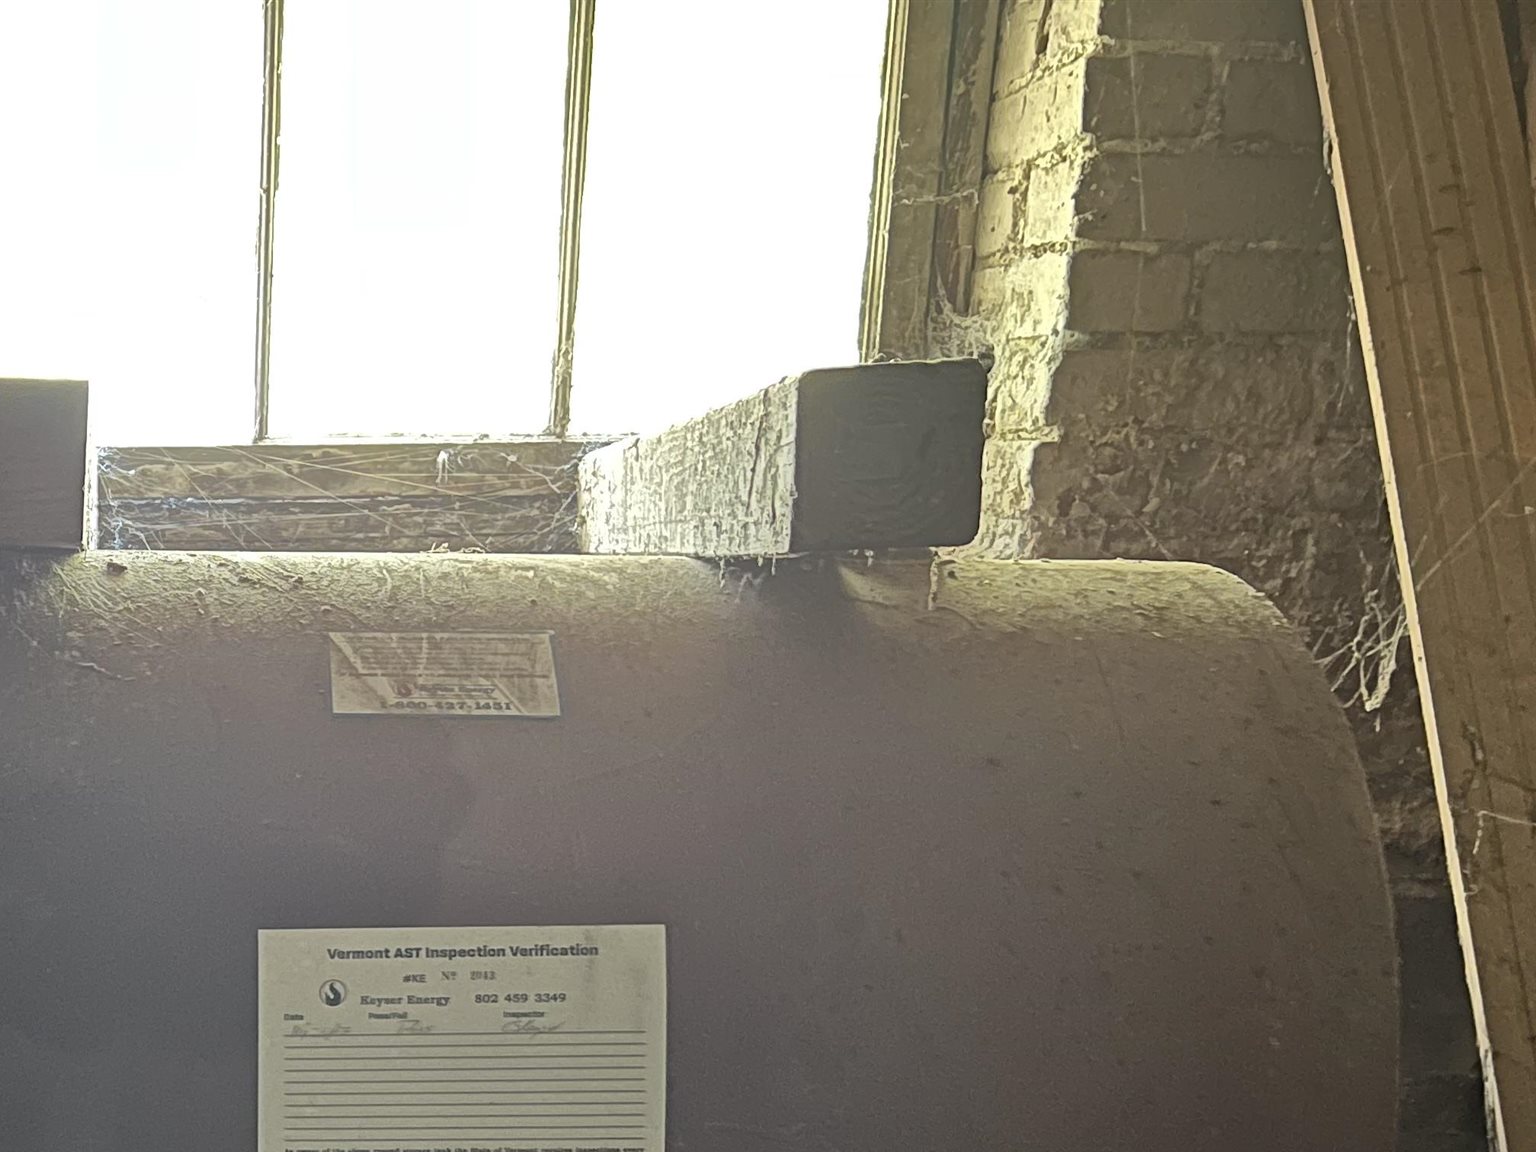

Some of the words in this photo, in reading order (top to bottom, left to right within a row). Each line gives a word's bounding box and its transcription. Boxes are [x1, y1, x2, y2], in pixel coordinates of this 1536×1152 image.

[327, 948, 391, 960] Vermont
[394, 947, 423, 959] AST
[425, 946, 506, 960] Inspection
[508, 943, 599, 958] Verification
[402, 974, 427, 984] #KE
[360, 996, 403, 1006] Keyser
[407, 995, 451, 1006] Energy
[474, 994, 499, 1004] 802
[503, 993, 529, 1003] 459
[534, 992, 567, 1003] 3349
